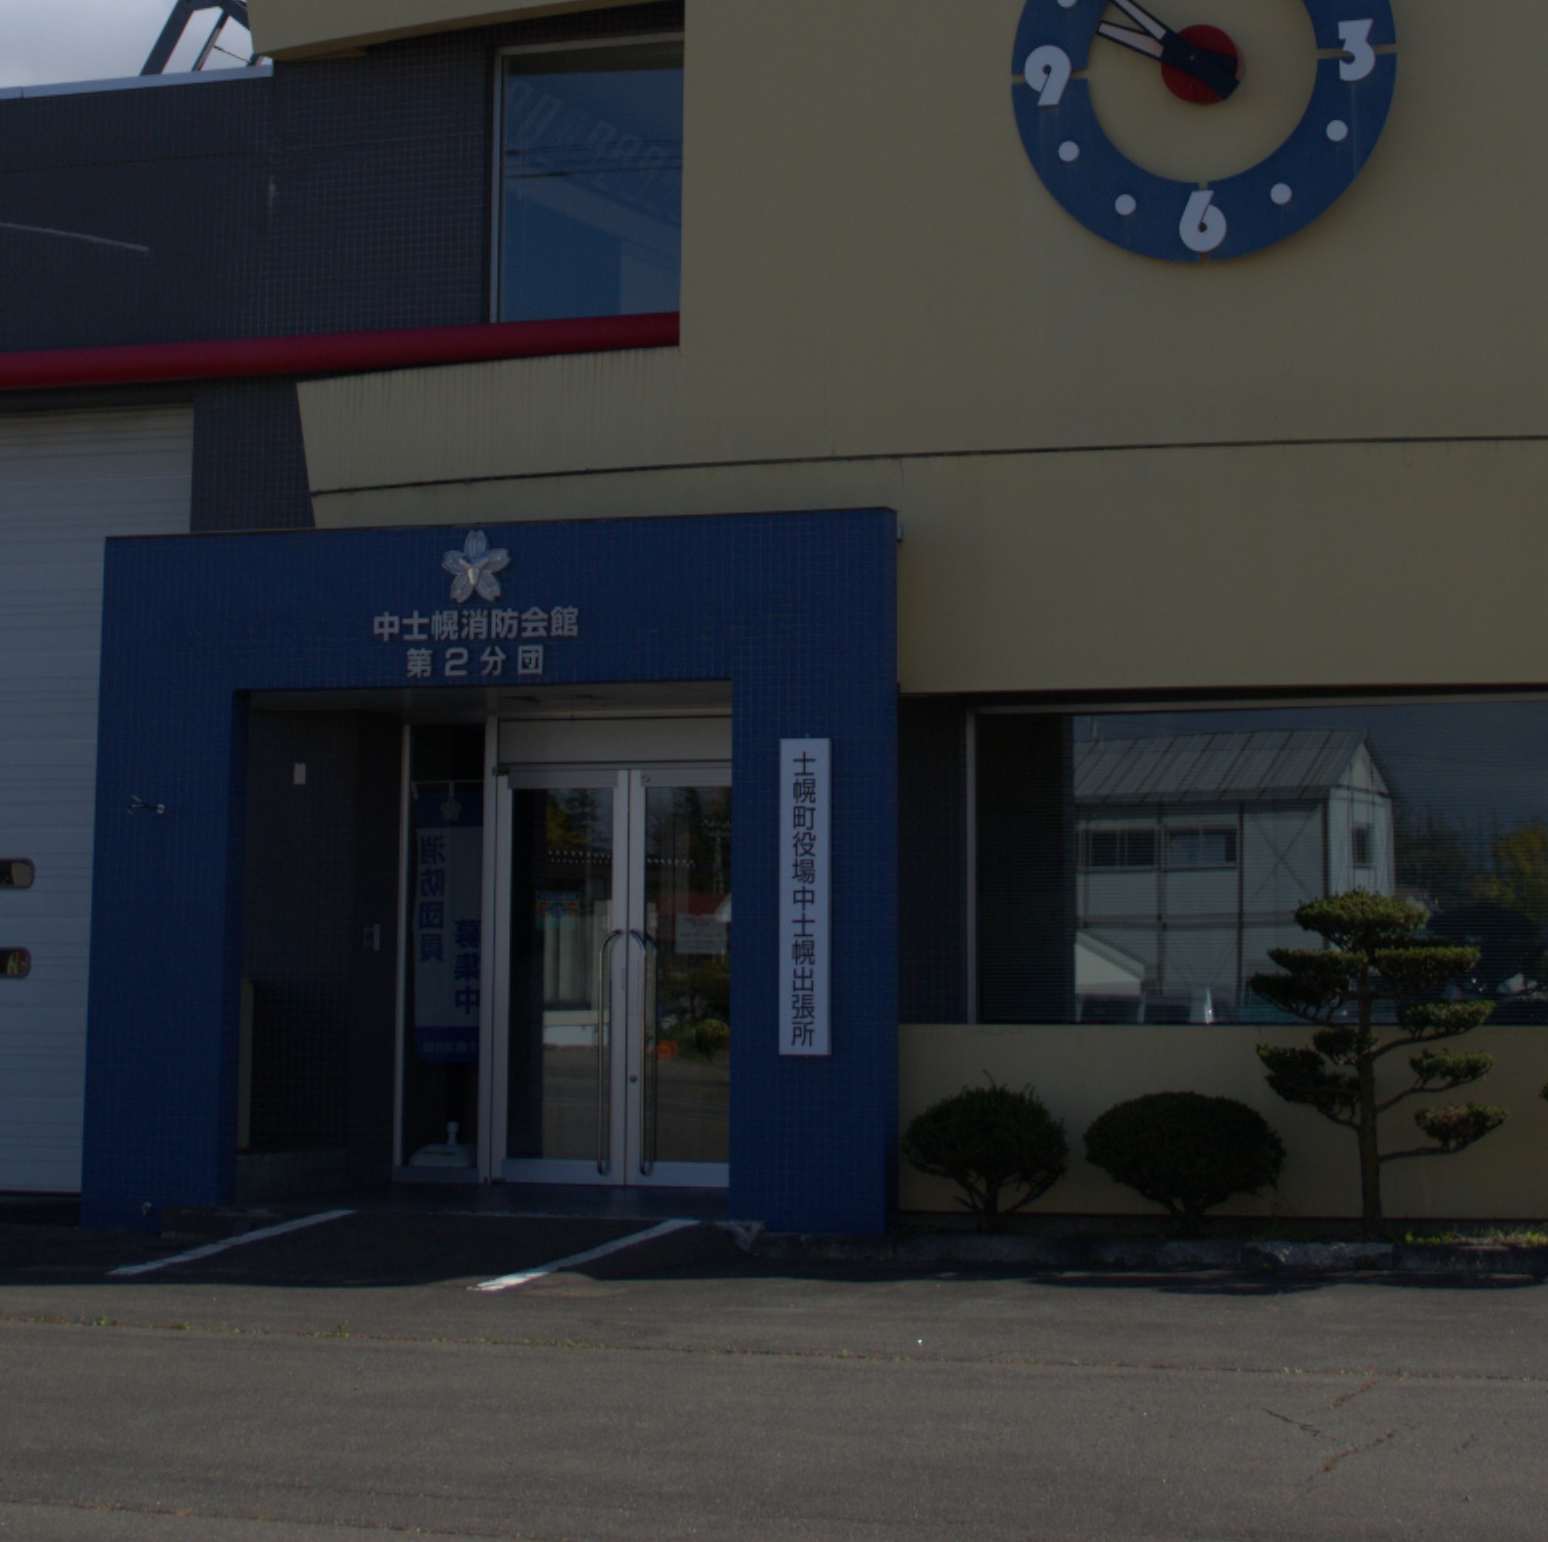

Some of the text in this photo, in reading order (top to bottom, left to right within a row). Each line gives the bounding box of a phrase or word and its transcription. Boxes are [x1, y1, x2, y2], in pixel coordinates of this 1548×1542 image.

[1024, 45, 1072, 107] 9
[1338, 18, 1376, 82] 3
[1179, 190, 1227, 253] 6
[372, 605, 579, 643] 中士幌消防会館
[405, 644, 545, 679] 第2分団
[791, 751, 816, 1048] 士幌町役場中士幌出張所
